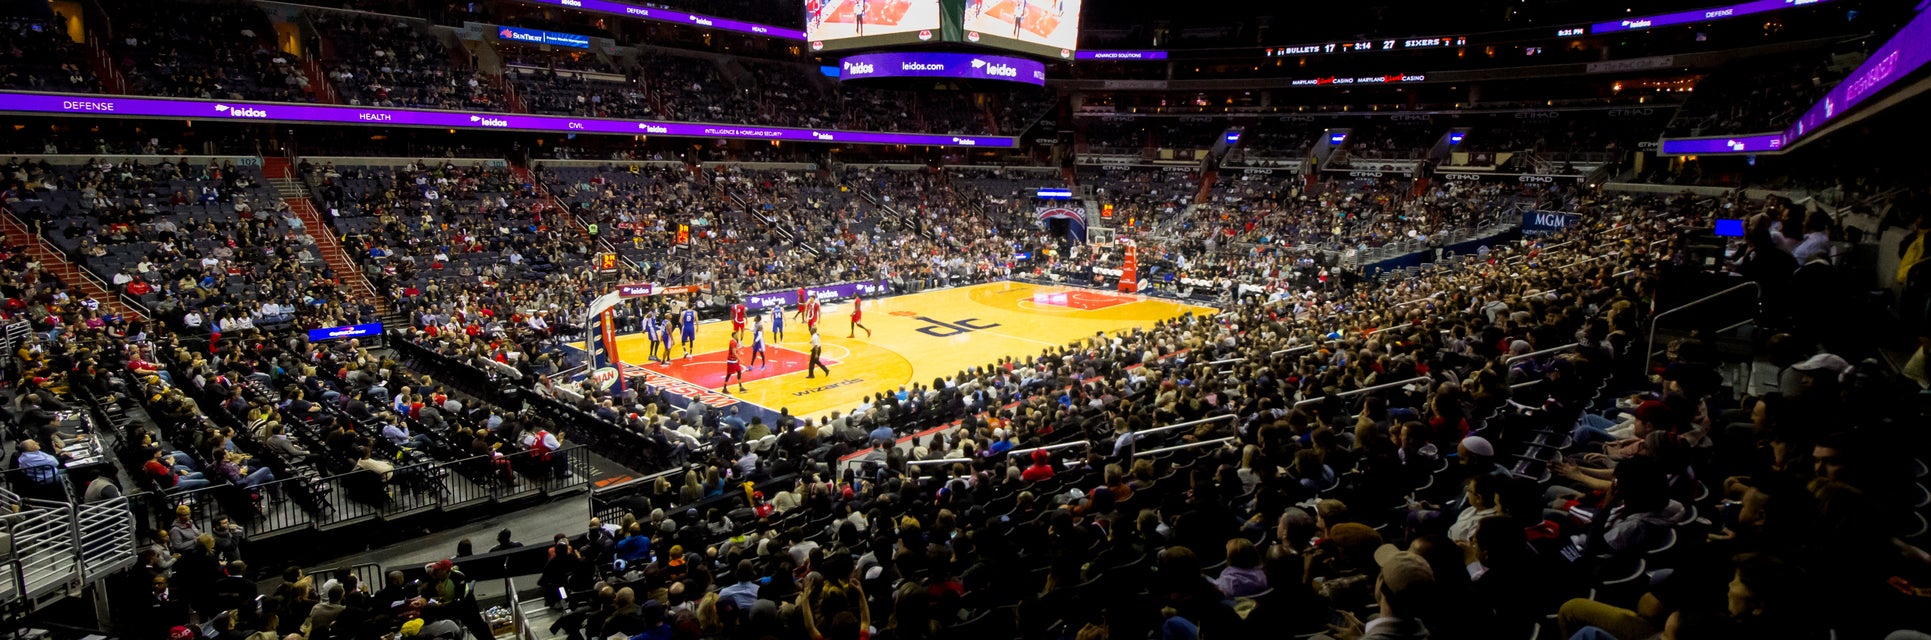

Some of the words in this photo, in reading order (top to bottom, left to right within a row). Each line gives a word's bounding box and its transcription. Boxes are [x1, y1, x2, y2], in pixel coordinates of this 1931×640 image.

[626, 7, 649, 16] DEFENSE
[1705, 8, 1733, 18] DEFENSE
[1629, 20, 1652, 29] leidos
[1285, 46, 1320, 54] BULLETS
[1324, 44, 1336, 53] 17
[1354, 42, 1371, 50] 3:14
[1382, 40, 1396, 50] 27
[1404, 38, 1440, 47] SIXERS
[849, 61, 874, 75] leidos
[902, 61, 944, 71] leidos.com
[986, 63, 1017, 77] leidos
[1390, 113, 1431, 121] ETIHAD
[1514, 111, 1559, 119] ETIHAD
[1608, 109, 1654, 117] ETIHAD
[63, 101, 114, 112] DEFENSE
[230, 106, 267, 118] leidos
[359, 112, 391, 121] HEALTH
[481, 117, 508, 128] leidos
[646, 124, 668, 134] leidos
[704, 128, 735, 136] INTELLIGENCE
[958, 138, 976, 146] leidos
[241, 158, 257, 166] 102
[1445, 174, 1480, 182] ETIHAD
[1518, 175, 1553, 183] ETIHAD
[1534, 212, 1566, 228] MGM
[630, 286, 650, 295] leidos
[761, 295, 786, 307] leidos
[816, 288, 839, 301] leidos
[865, 283, 885, 293] leios
[915, 315, 1002, 338] dc
[792, 377, 866, 398] wizards
